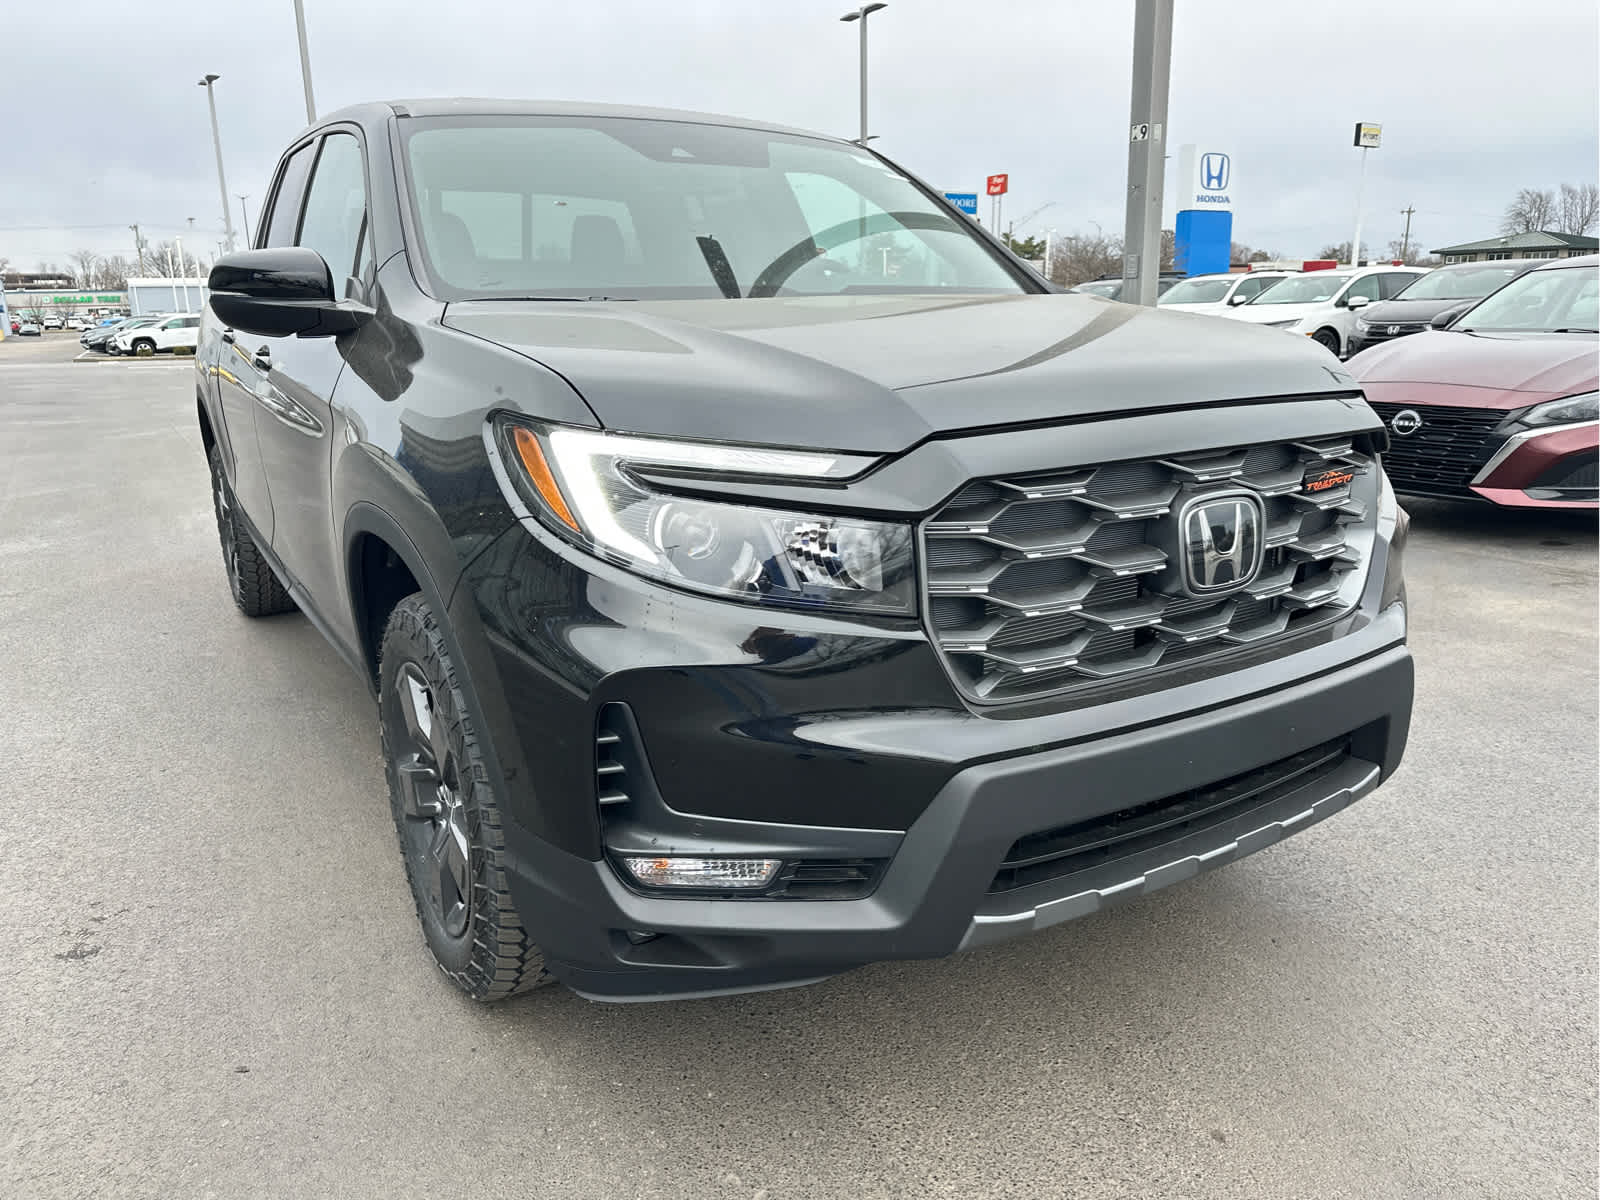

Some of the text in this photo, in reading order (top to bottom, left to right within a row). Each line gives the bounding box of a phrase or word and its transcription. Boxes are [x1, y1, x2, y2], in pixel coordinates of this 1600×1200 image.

[1196, 194, 1231, 204] HONDA
[53, 296, 93, 304] DOLLAR
[1391, 419, 1422, 427] NISSAN
